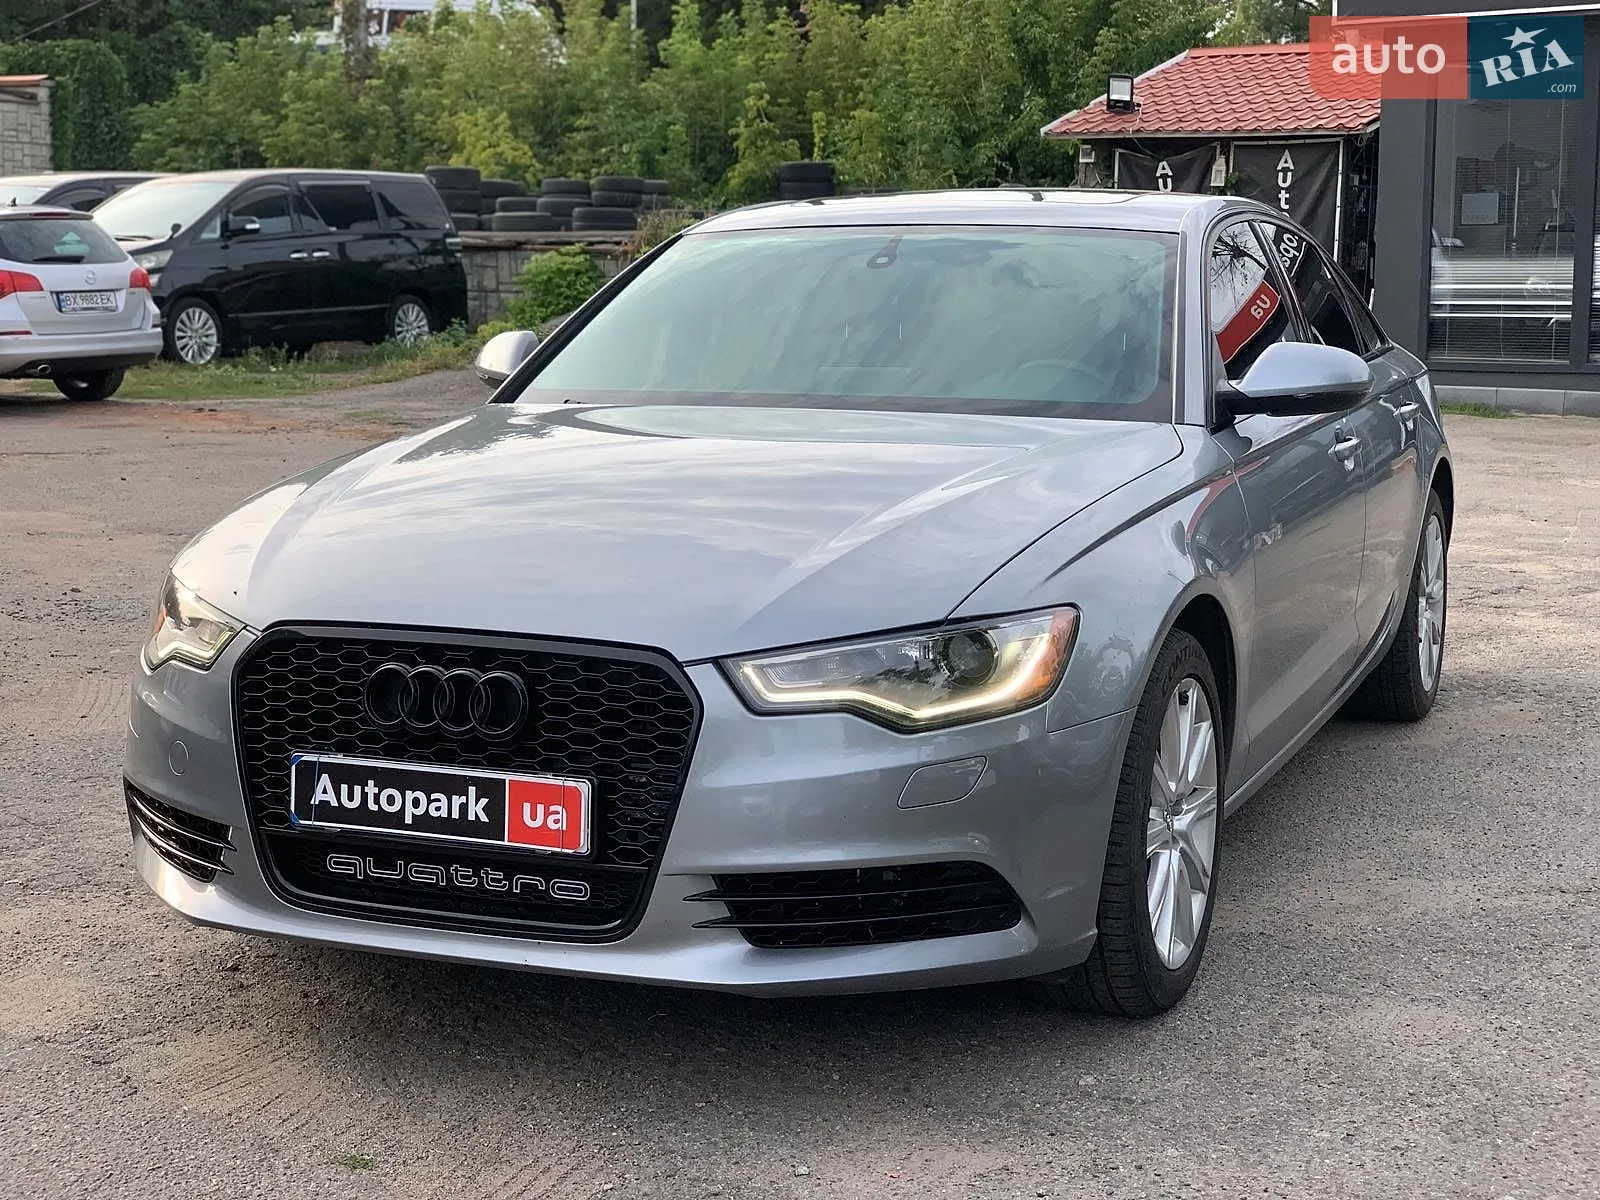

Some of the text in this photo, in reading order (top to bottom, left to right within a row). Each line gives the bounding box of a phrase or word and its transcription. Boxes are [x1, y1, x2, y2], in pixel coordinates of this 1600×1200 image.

[310, 773, 567, 831] Autopark ua
[326, 853, 591, 901] quattro
